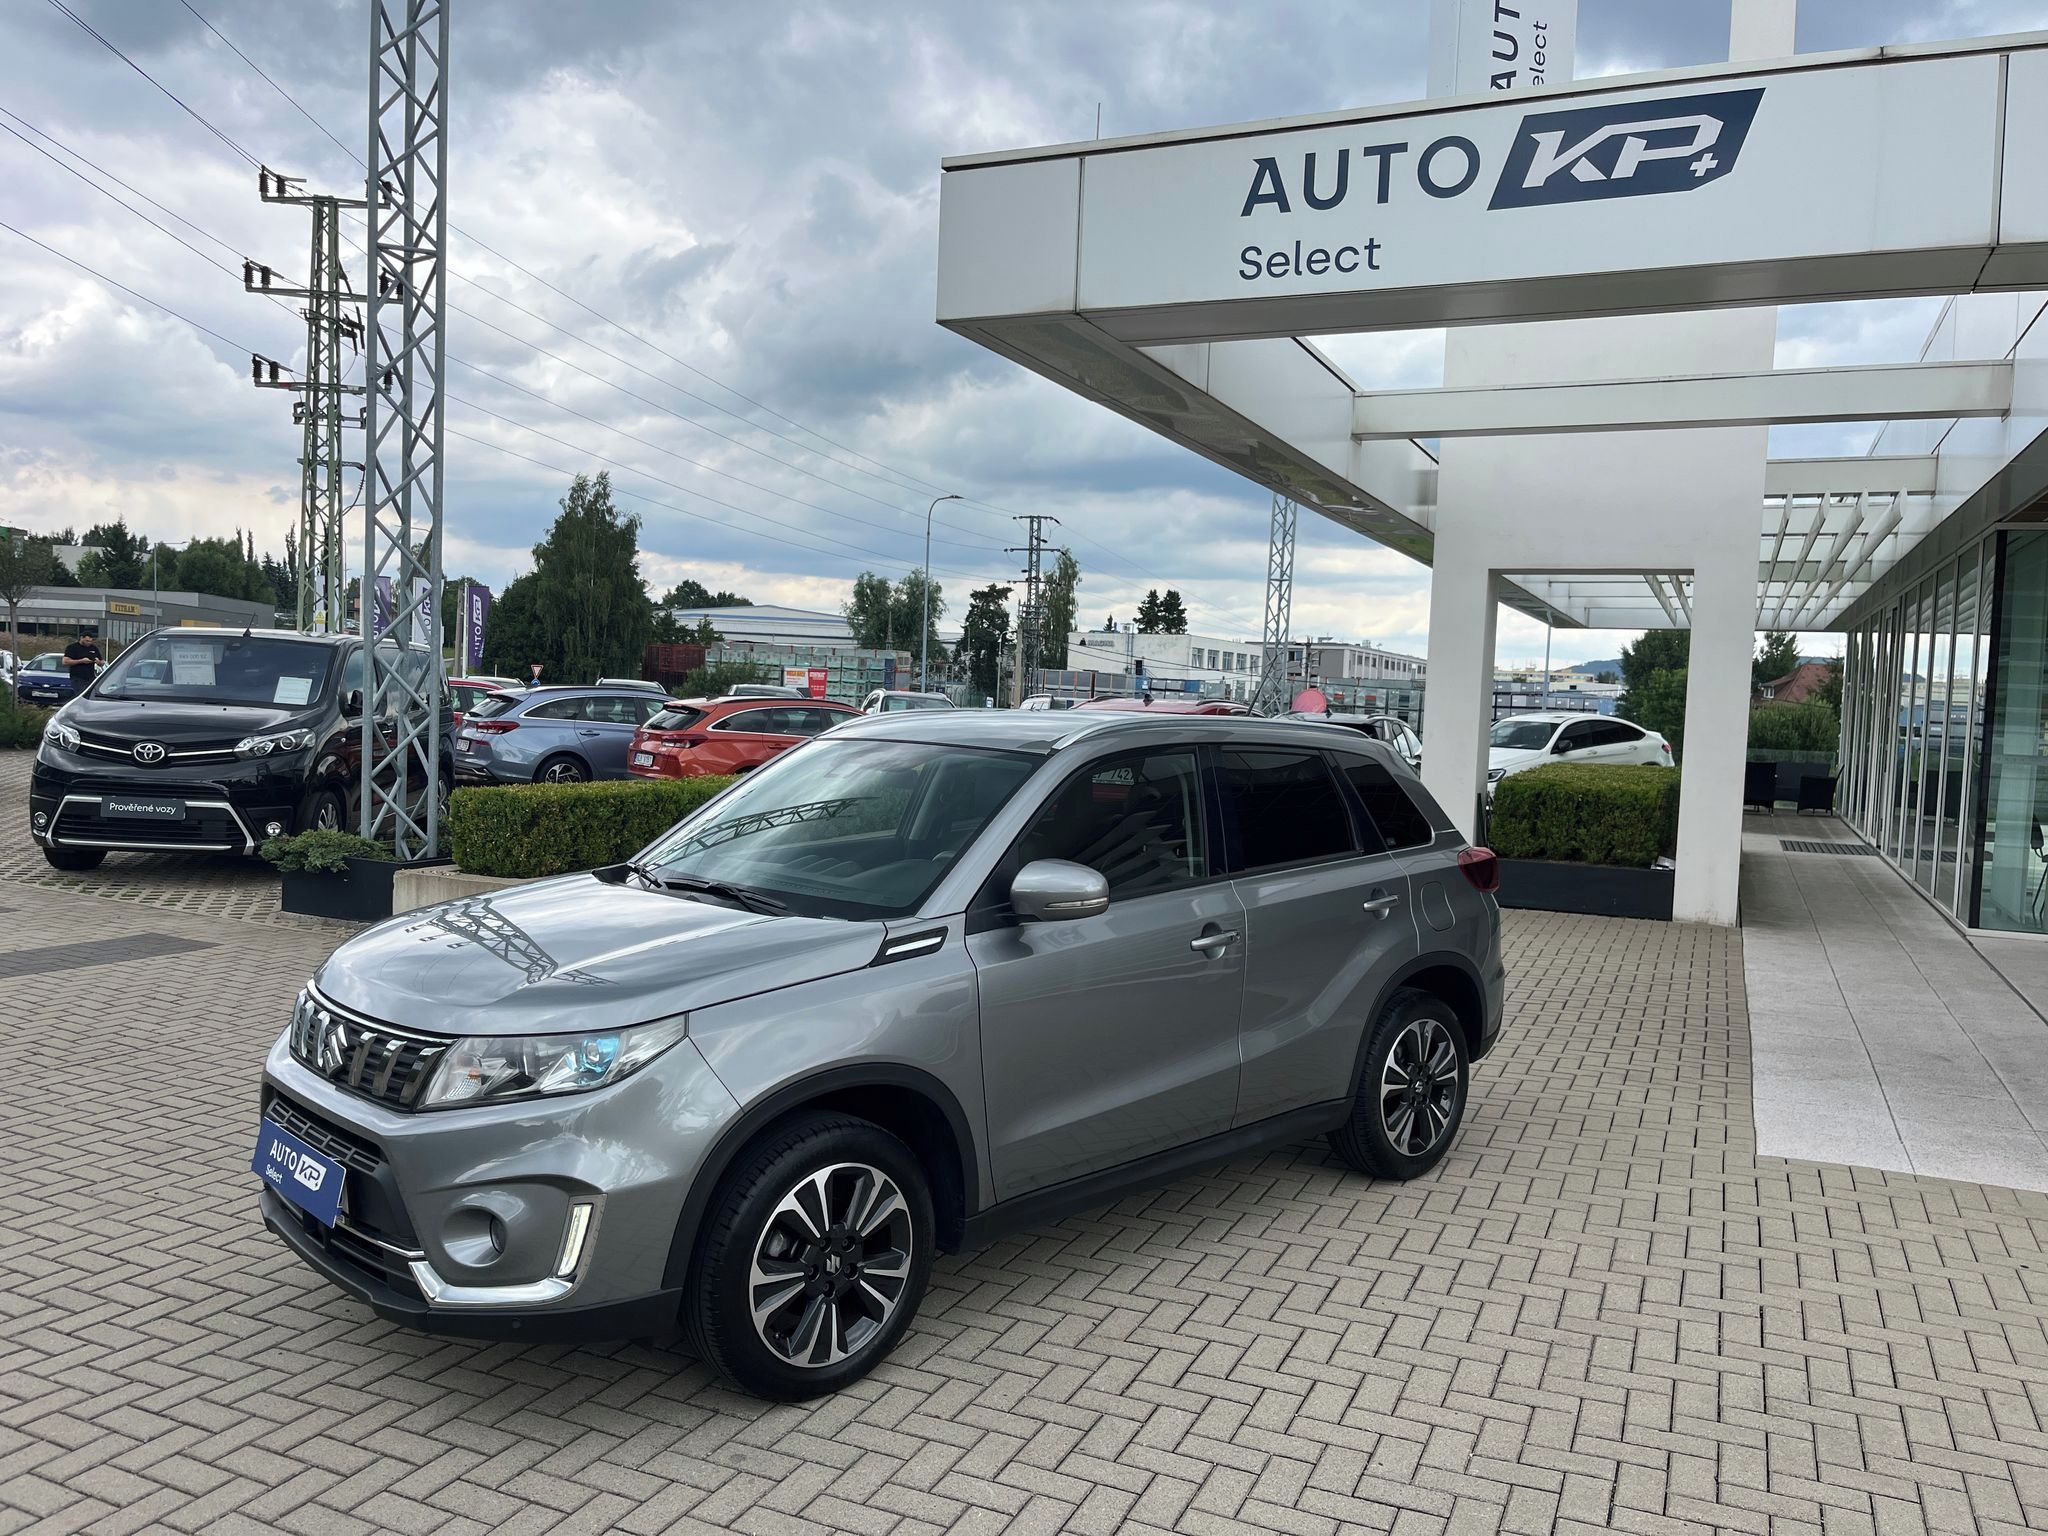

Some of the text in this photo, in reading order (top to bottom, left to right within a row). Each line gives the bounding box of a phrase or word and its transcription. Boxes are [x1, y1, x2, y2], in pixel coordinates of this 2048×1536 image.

[1529, 20, 1548, 86] elect
[1240, 135, 1481, 217] AUTO
[1239, 237, 1382, 281] Select
[109, 802, 177, 815] Prověřené vozy
[265, 1163, 284, 1185] Select
[269, 1139, 298, 1171] AUTO
